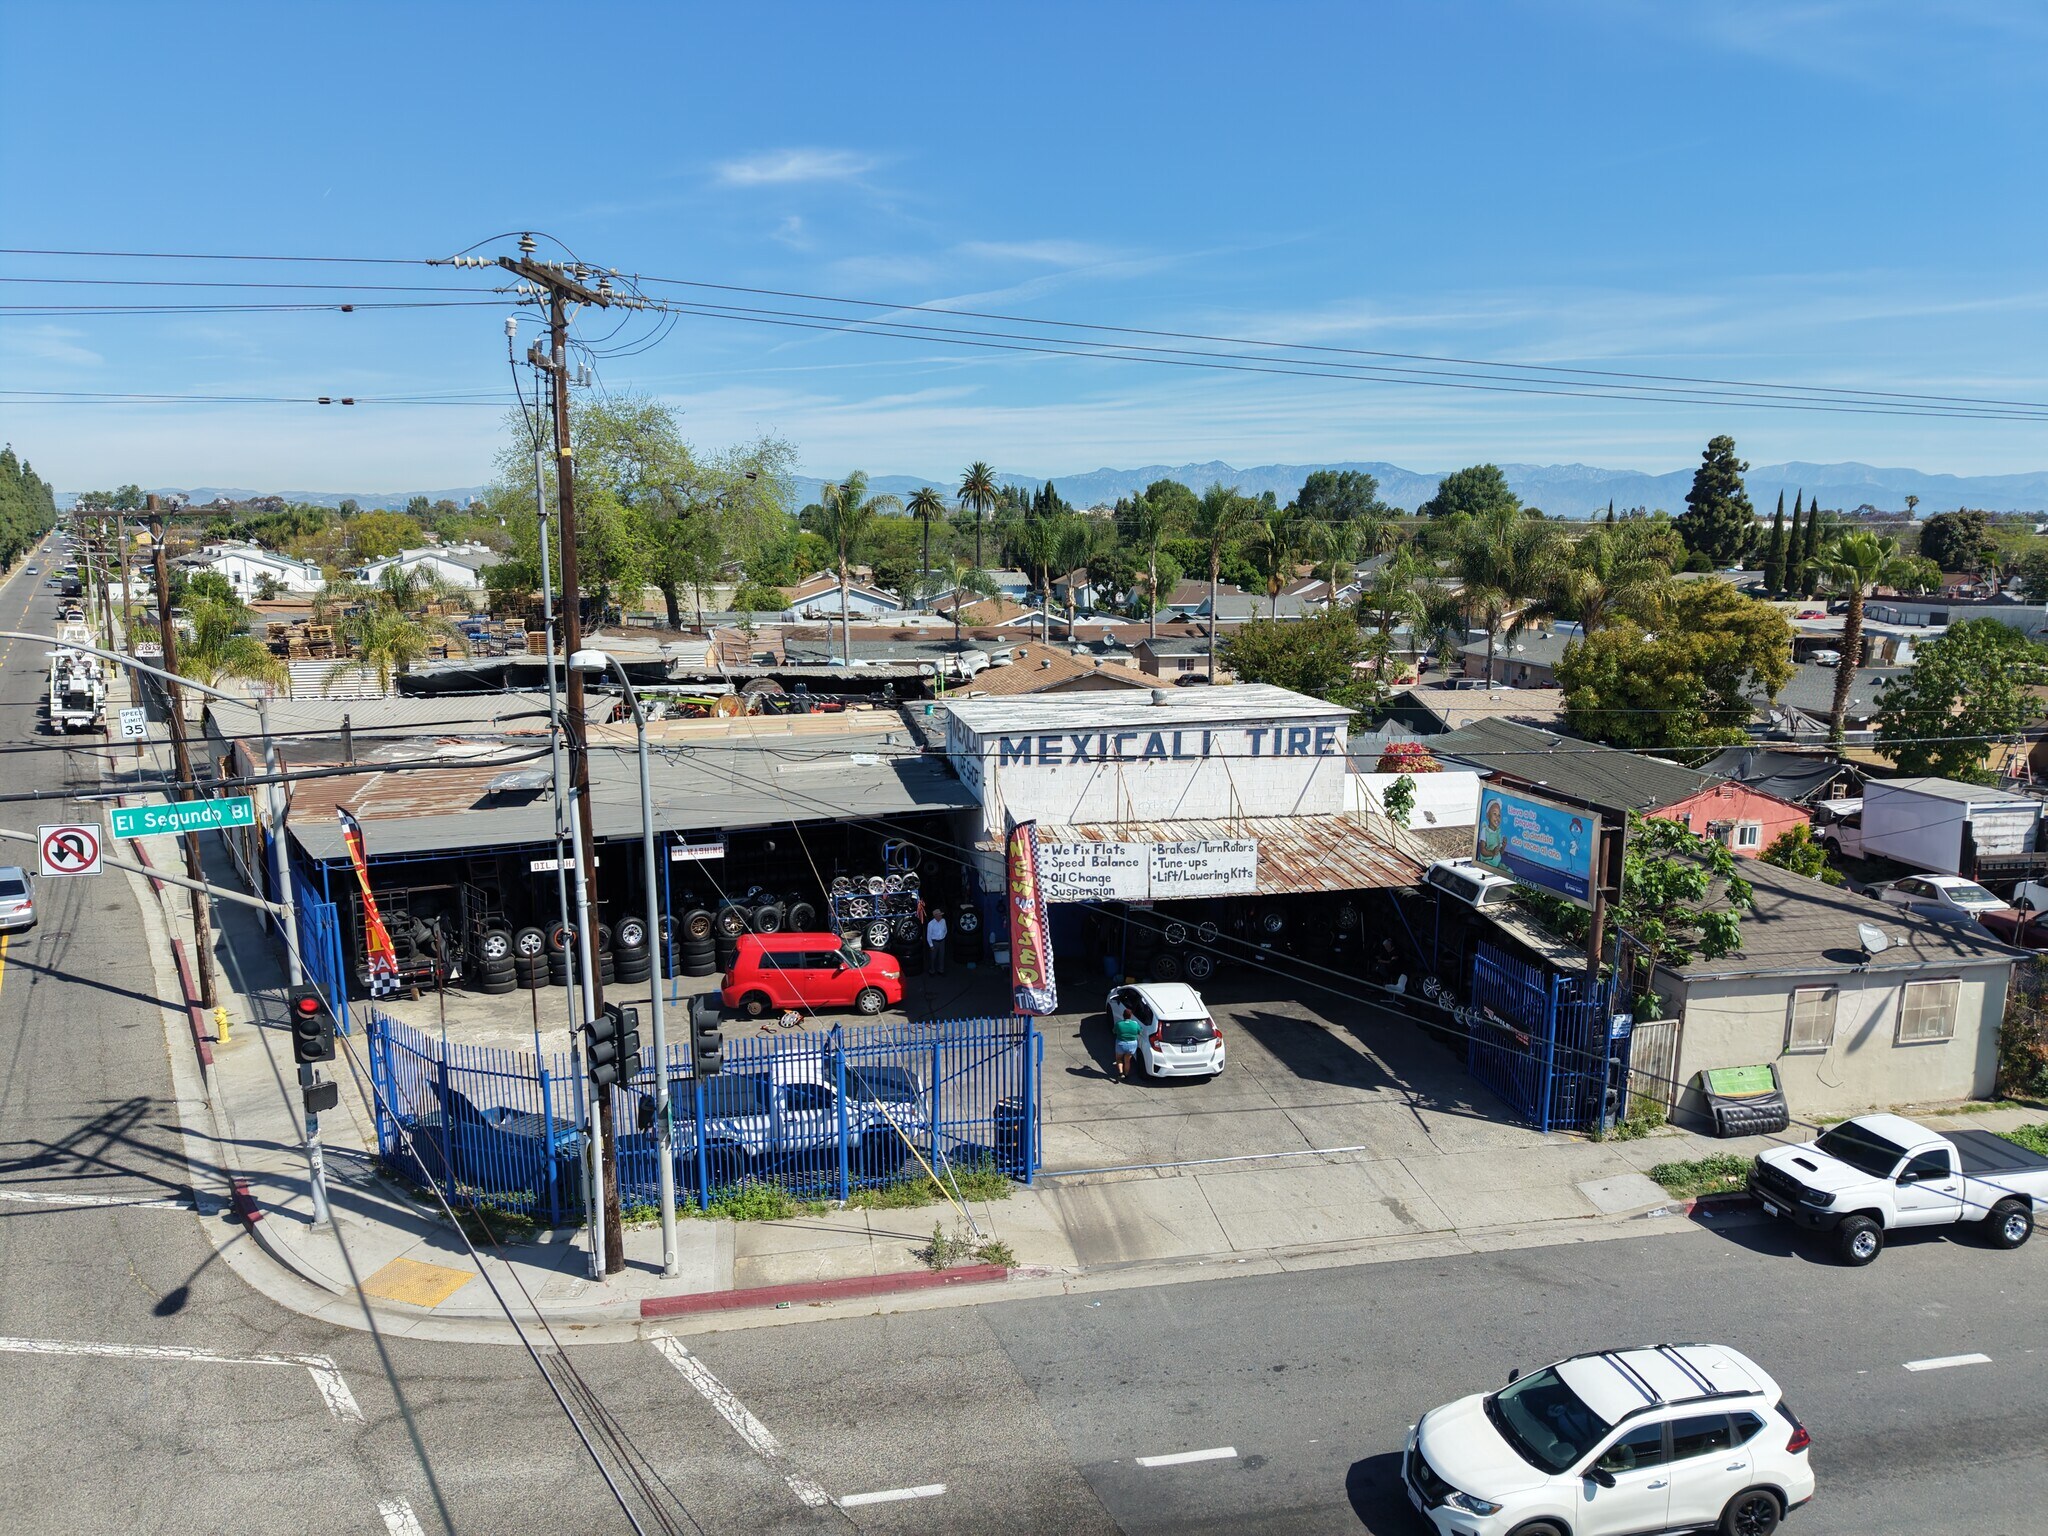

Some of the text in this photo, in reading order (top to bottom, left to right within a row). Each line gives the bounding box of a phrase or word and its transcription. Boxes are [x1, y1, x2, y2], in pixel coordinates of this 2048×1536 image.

[125, 725, 144, 735] 35
[1000, 731, 1211, 767] MEXICALI
[1246, 726, 1336, 757] TIRE
[116, 803, 249, 832] El Segundo Bl
[672, 846, 723, 857] NO WASHING
[1051, 844, 1126, 855] We Fix Flats
[1051, 855, 1139, 872] Speed Balance
[1157, 857, 1208, 870] Tune-ups
[1051, 871, 1112, 887] Oil Change
[1050, 885, 1116, 900] Suspension
[1016, 992, 1053, 1011] TIRES
